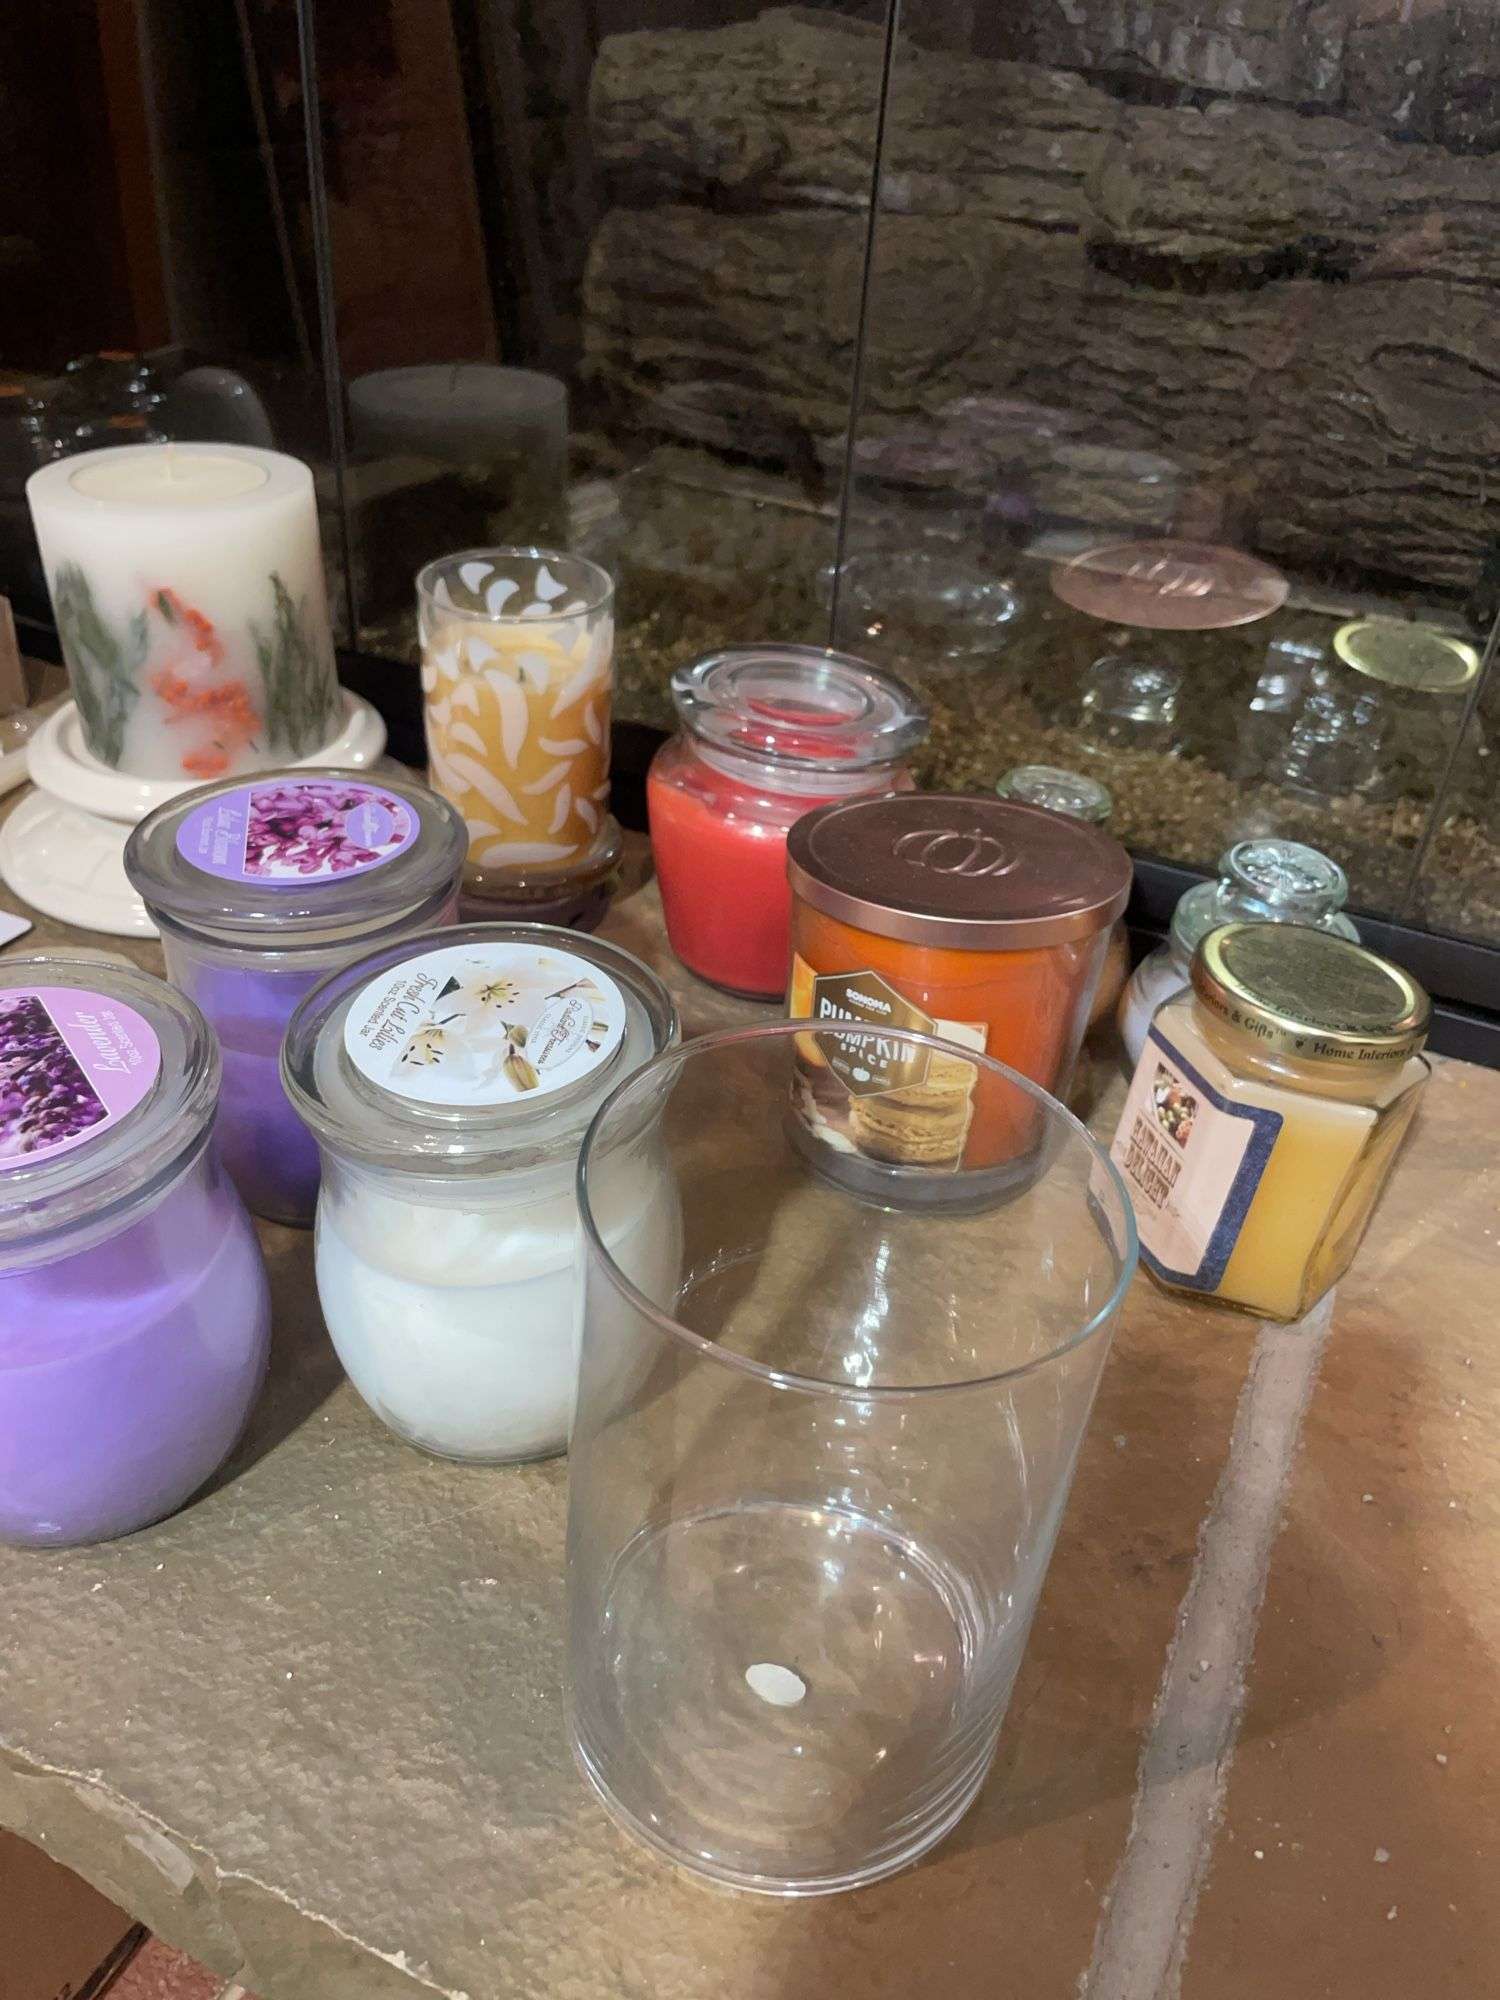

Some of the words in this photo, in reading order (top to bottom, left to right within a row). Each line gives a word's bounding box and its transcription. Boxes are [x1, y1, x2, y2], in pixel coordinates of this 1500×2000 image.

[403, 972, 438, 1004] Fresh
[845, 988, 892, 1013] SONOMA
[390, 1001, 420, 1023] Cut
[368, 1019, 405, 1050] Lilies
[840, 1042, 889, 1069] SPICE
[1313, 1042, 1354, 1059] Home
